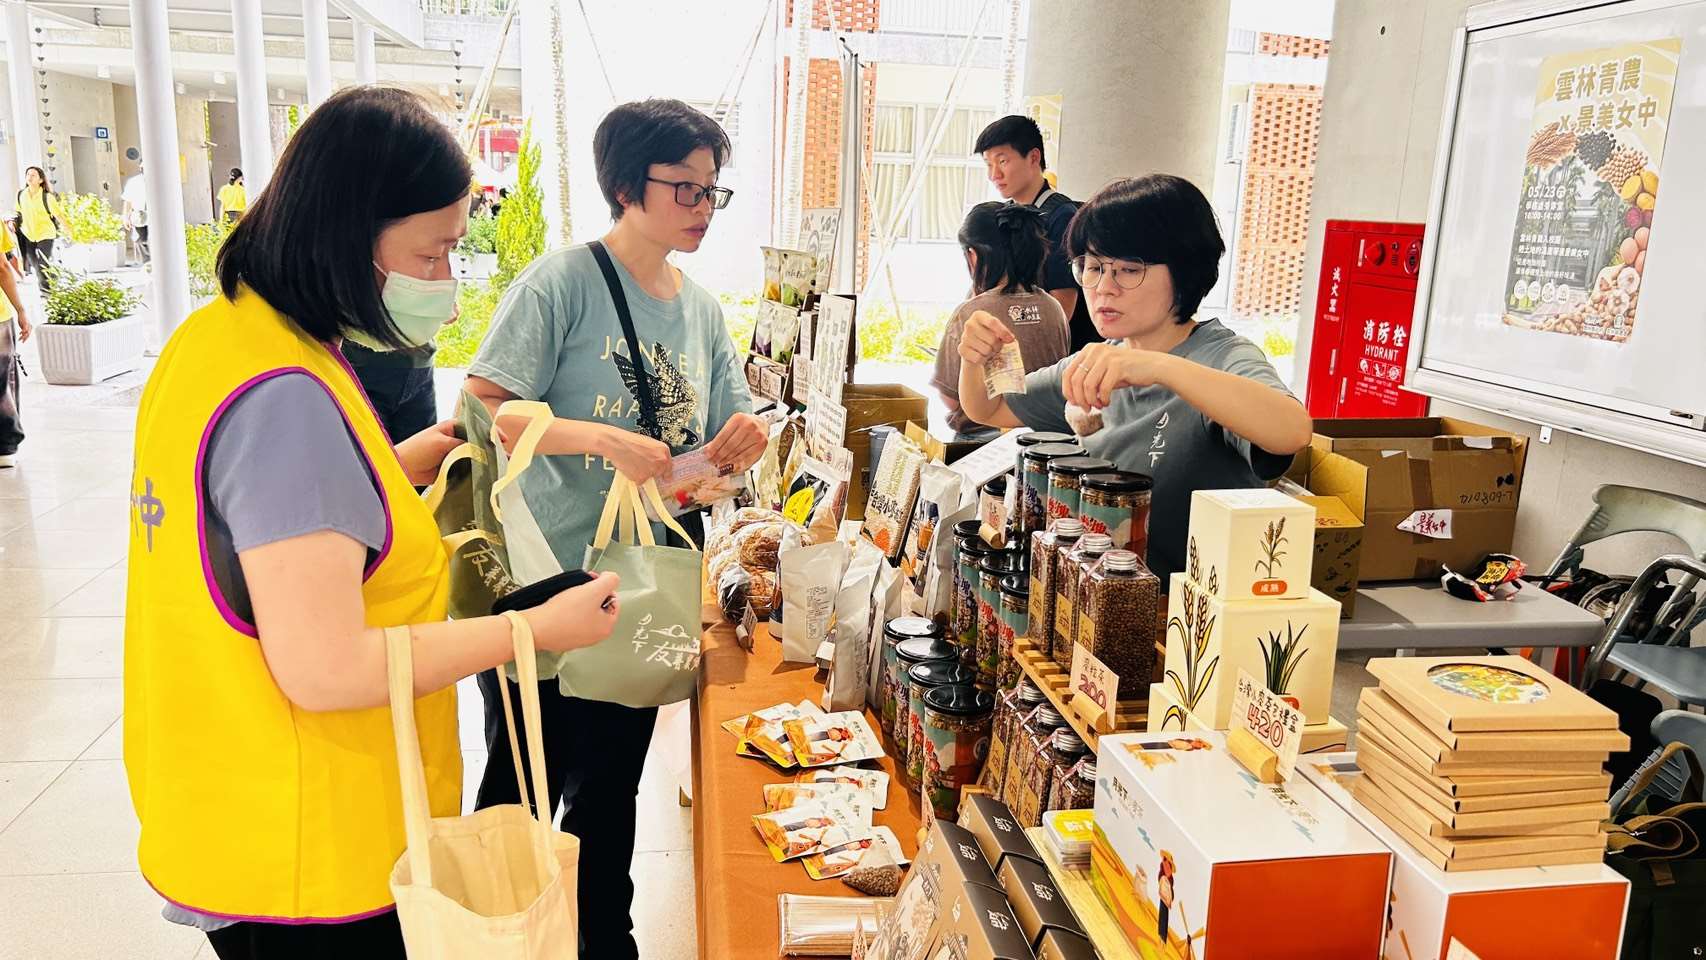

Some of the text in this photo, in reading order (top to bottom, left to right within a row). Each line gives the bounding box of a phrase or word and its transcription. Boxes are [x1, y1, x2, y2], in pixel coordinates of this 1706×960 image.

[1556, 58, 1641, 101] 雲林青農
[1576, 97, 1656, 132] 景美女中
[1363, 319, 1408, 347] 消防栓
[1364, 344, 1399, 362] HYDRANT
[1148, 411, 1169, 468] 月光下
[131, 477, 165, 552] 中
[632, 613, 652, 653] 月光下
[1078, 673, 1107, 709] 200
[1247, 702, 1283, 748] 420
